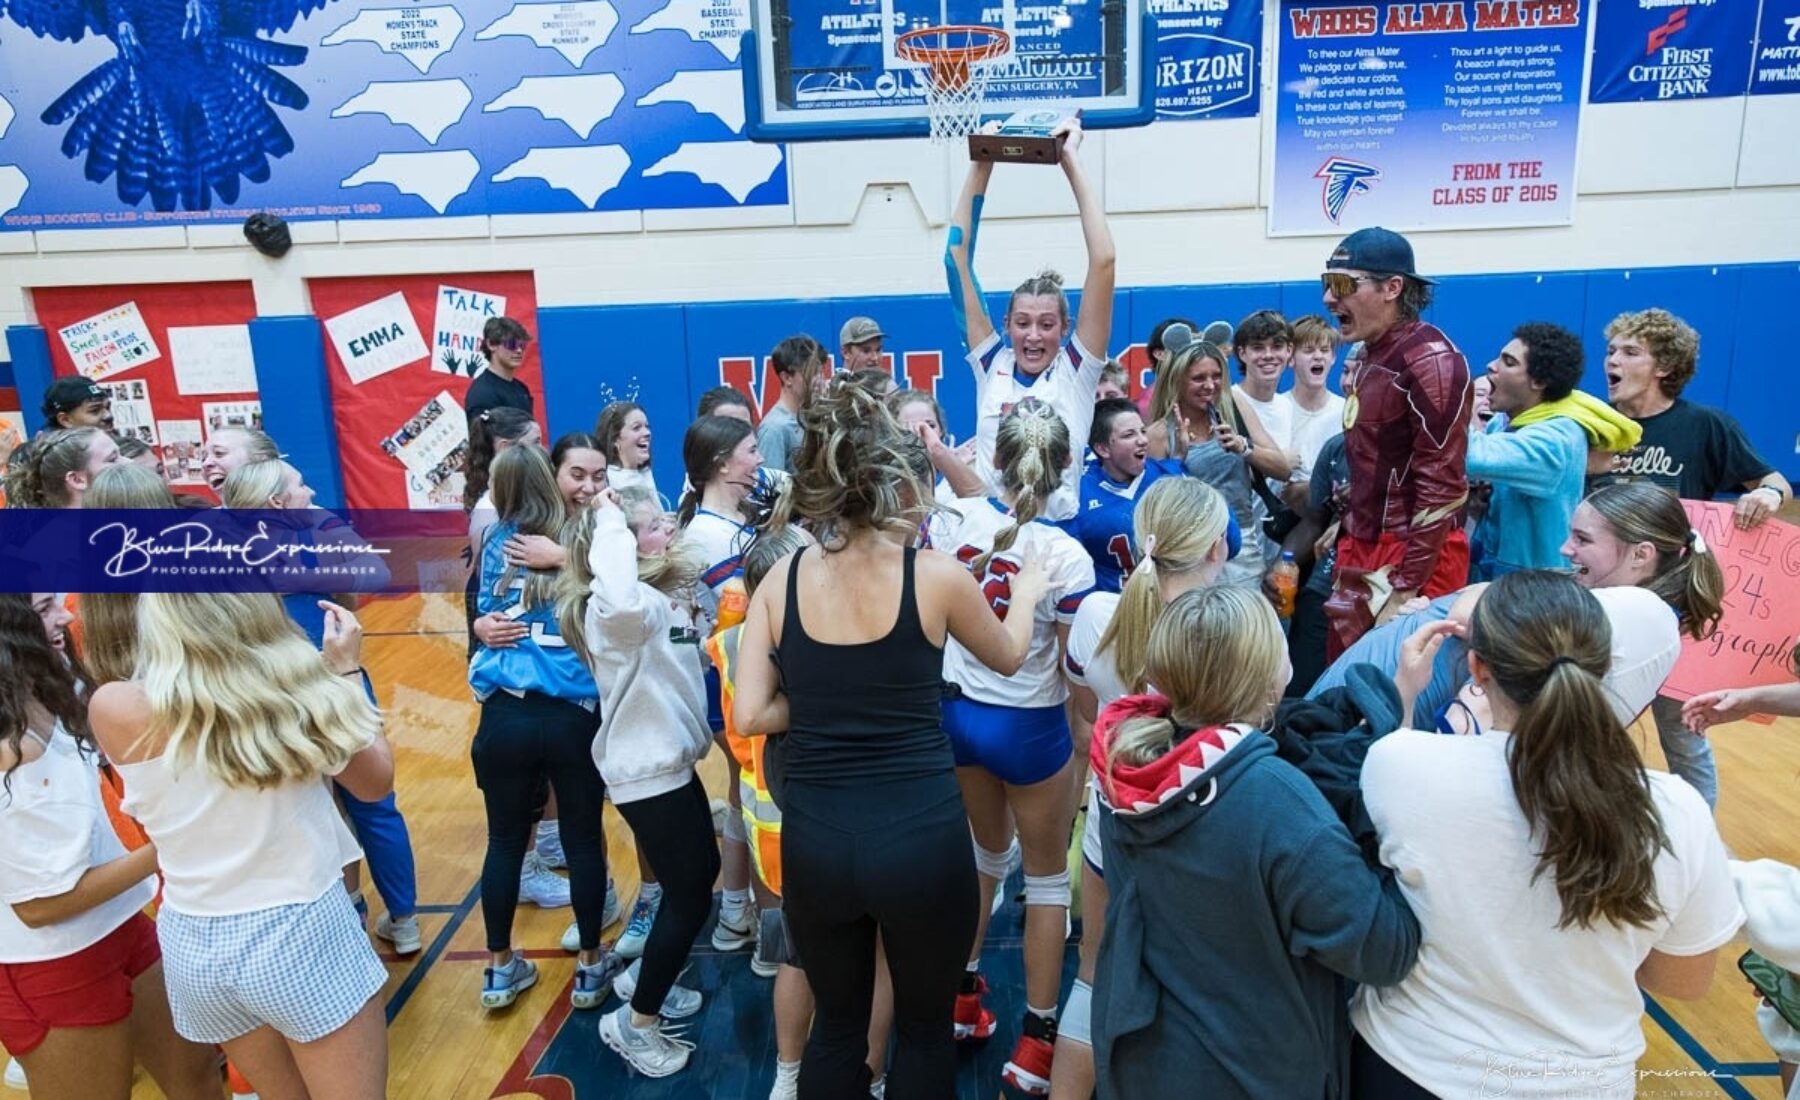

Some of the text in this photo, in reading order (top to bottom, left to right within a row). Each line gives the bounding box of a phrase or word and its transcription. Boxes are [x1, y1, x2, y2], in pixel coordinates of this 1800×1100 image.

[401, 10, 420, 18] 2022
[700, 8, 743, 18] BASEBALL
[1290, 0, 1579, 38] WHHS ALMA MATER
[710, 19, 736, 28] STATE
[1206, 15, 1222, 28] by:
[400, 30, 426, 39] STATE
[390, 40, 439, 50] CHAMPIONS
[1450, 48, 1472, 56] Thou
[1473, 47, 1486, 56] art
[1494, 46, 1512, 56] light
[1514, 46, 1523, 54] to
[1525, 44, 1548, 56] guide
[1308, 46, 1400, 58] To thee our Alma Mater
[1661, 47, 1713, 66] FIRST
[1299, 64, 1313, 72] We
[1314, 62, 1341, 74] pledge
[1455, 60, 1463, 68] A
[1464, 59, 1494, 68] beacon
[1496, 58, 1524, 69] always
[1454, 70, 1556, 81] Our source of inspiration
[1628, 64, 1712, 82] CITIZENS
[1010, 82, 1063, 92] SURGERY,
[1066, 80, 1079, 90] PA
[1306, 76, 1318, 86] We
[1321, 76, 1356, 84] dedicate
[1188, 85, 1213, 95] HEAT
[1226, 80, 1243, 91] AIR
[1314, 88, 1326, 98] red
[1328, 88, 1344, 97] and
[1346, 88, 1366, 96] white
[1368, 86, 1383, 96] and
[1444, 85, 1456, 94] To
[1456, 84, 1480, 94] teach
[1494, 84, 1512, 94] right
[1514, 82, 1534, 91] from
[1658, 79, 1708, 99] BANK
[1296, 103, 1304, 112] In
[1305, 102, 1326, 111] these
[1344, 101, 1362, 110] halls
[1363, 100, 1372, 109] of
[1444, 97, 1459, 108] Thy
[1460, 96, 1480, 107] loyal
[1482, 97, 1502, 106] sons
[1504, 96, 1520, 104] and
[1461, 109, 1492, 118] Forever
[1508, 106, 1528, 116] shall
[1298, 116, 1314, 125] True
[1316, 115, 1359, 125] knowledge
[1360, 116, 1376, 124] you
[1304, 127, 1395, 138] May you remain forever
[1442, 122, 1477, 132] Devoted
[1478, 121, 1506, 131] always
[1507, 121, 1517, 130] to
[1452, 161, 1542, 181] FROM THE
[1432, 184, 1558, 206] CLASS OF 2015
[443, 290, 496, 316] TALK
[348, 322, 404, 358] EMMA
